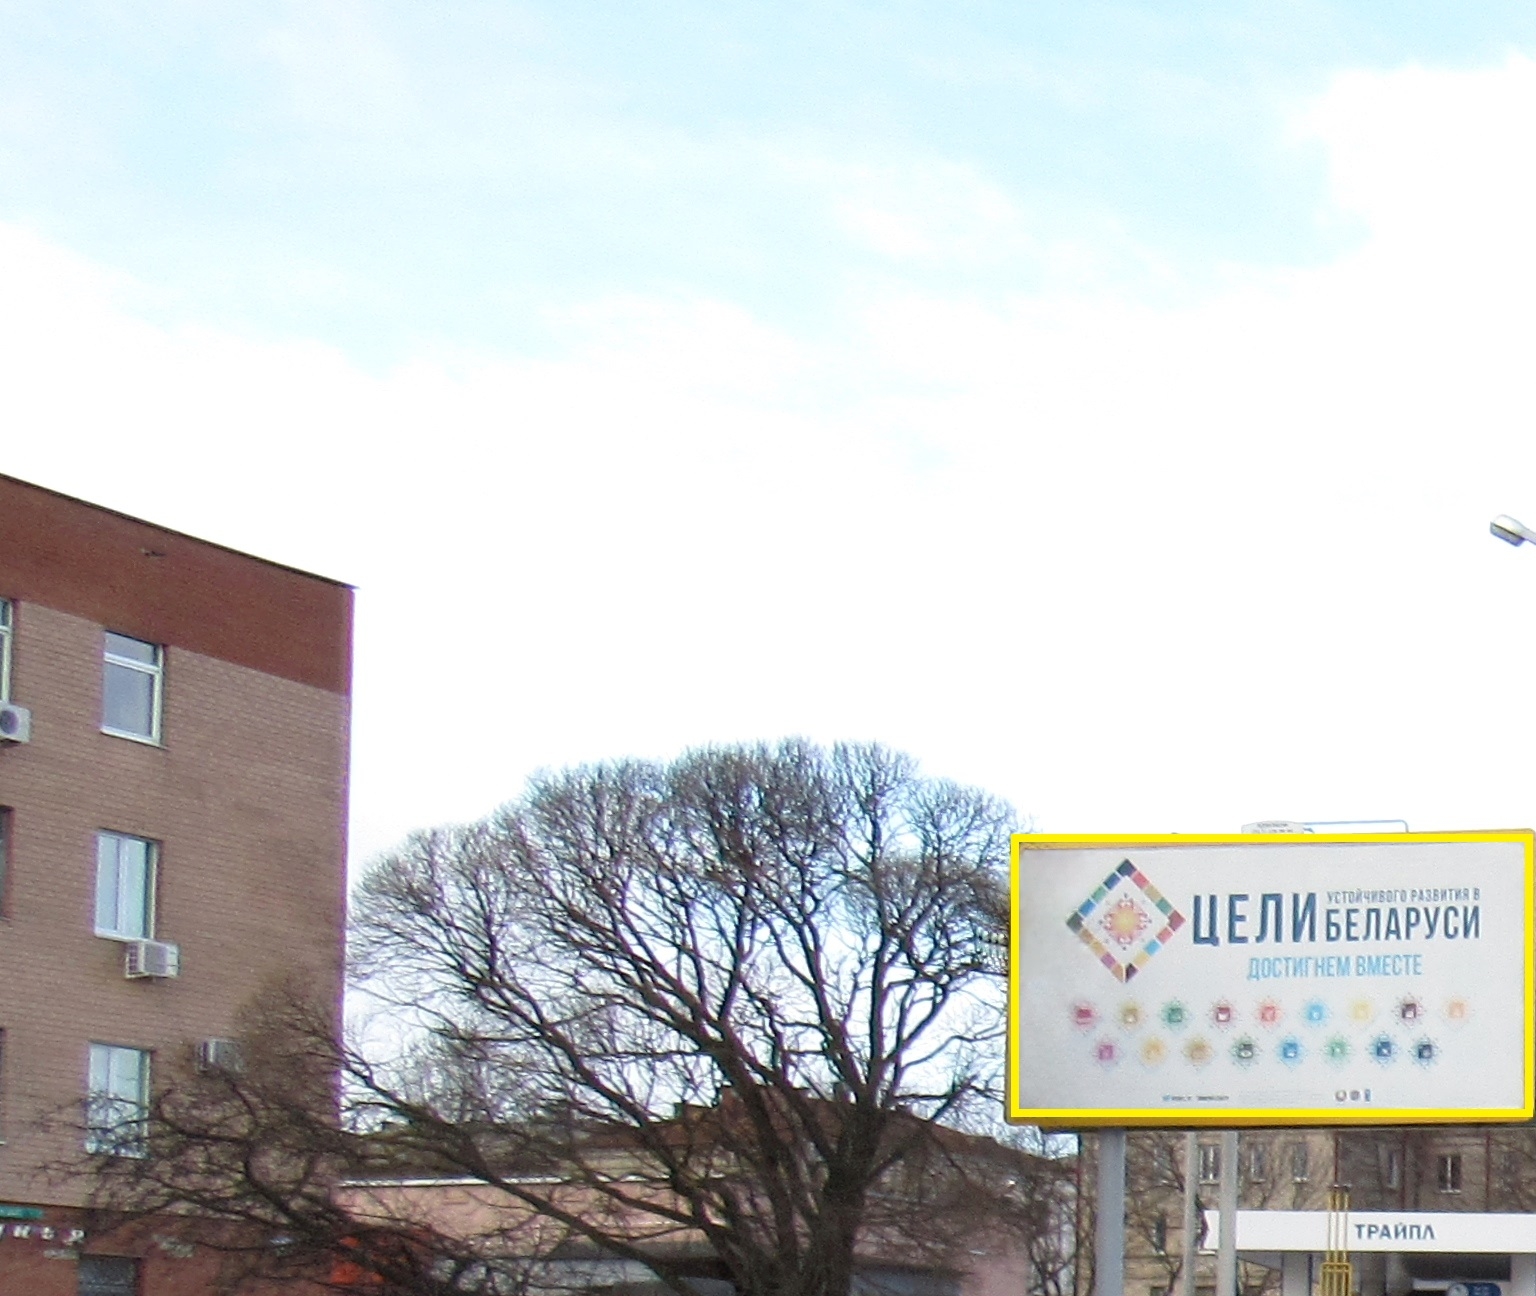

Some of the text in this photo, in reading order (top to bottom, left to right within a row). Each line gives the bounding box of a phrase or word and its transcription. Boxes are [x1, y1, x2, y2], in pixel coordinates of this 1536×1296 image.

[1326, 887, 1481, 905] УСТОЙЧИВОГО РАЗВИТИЯ В
[1192, 892, 1316, 946] ЦЕЛИ
[1325, 905, 1481, 943] БЕЛАРУСИ
[1246, 954, 1423, 981] ДОСТИГНЕМ ВМЕСТЕ
[1354, 1221, 1436, 1241] ТРАЙПЛ
